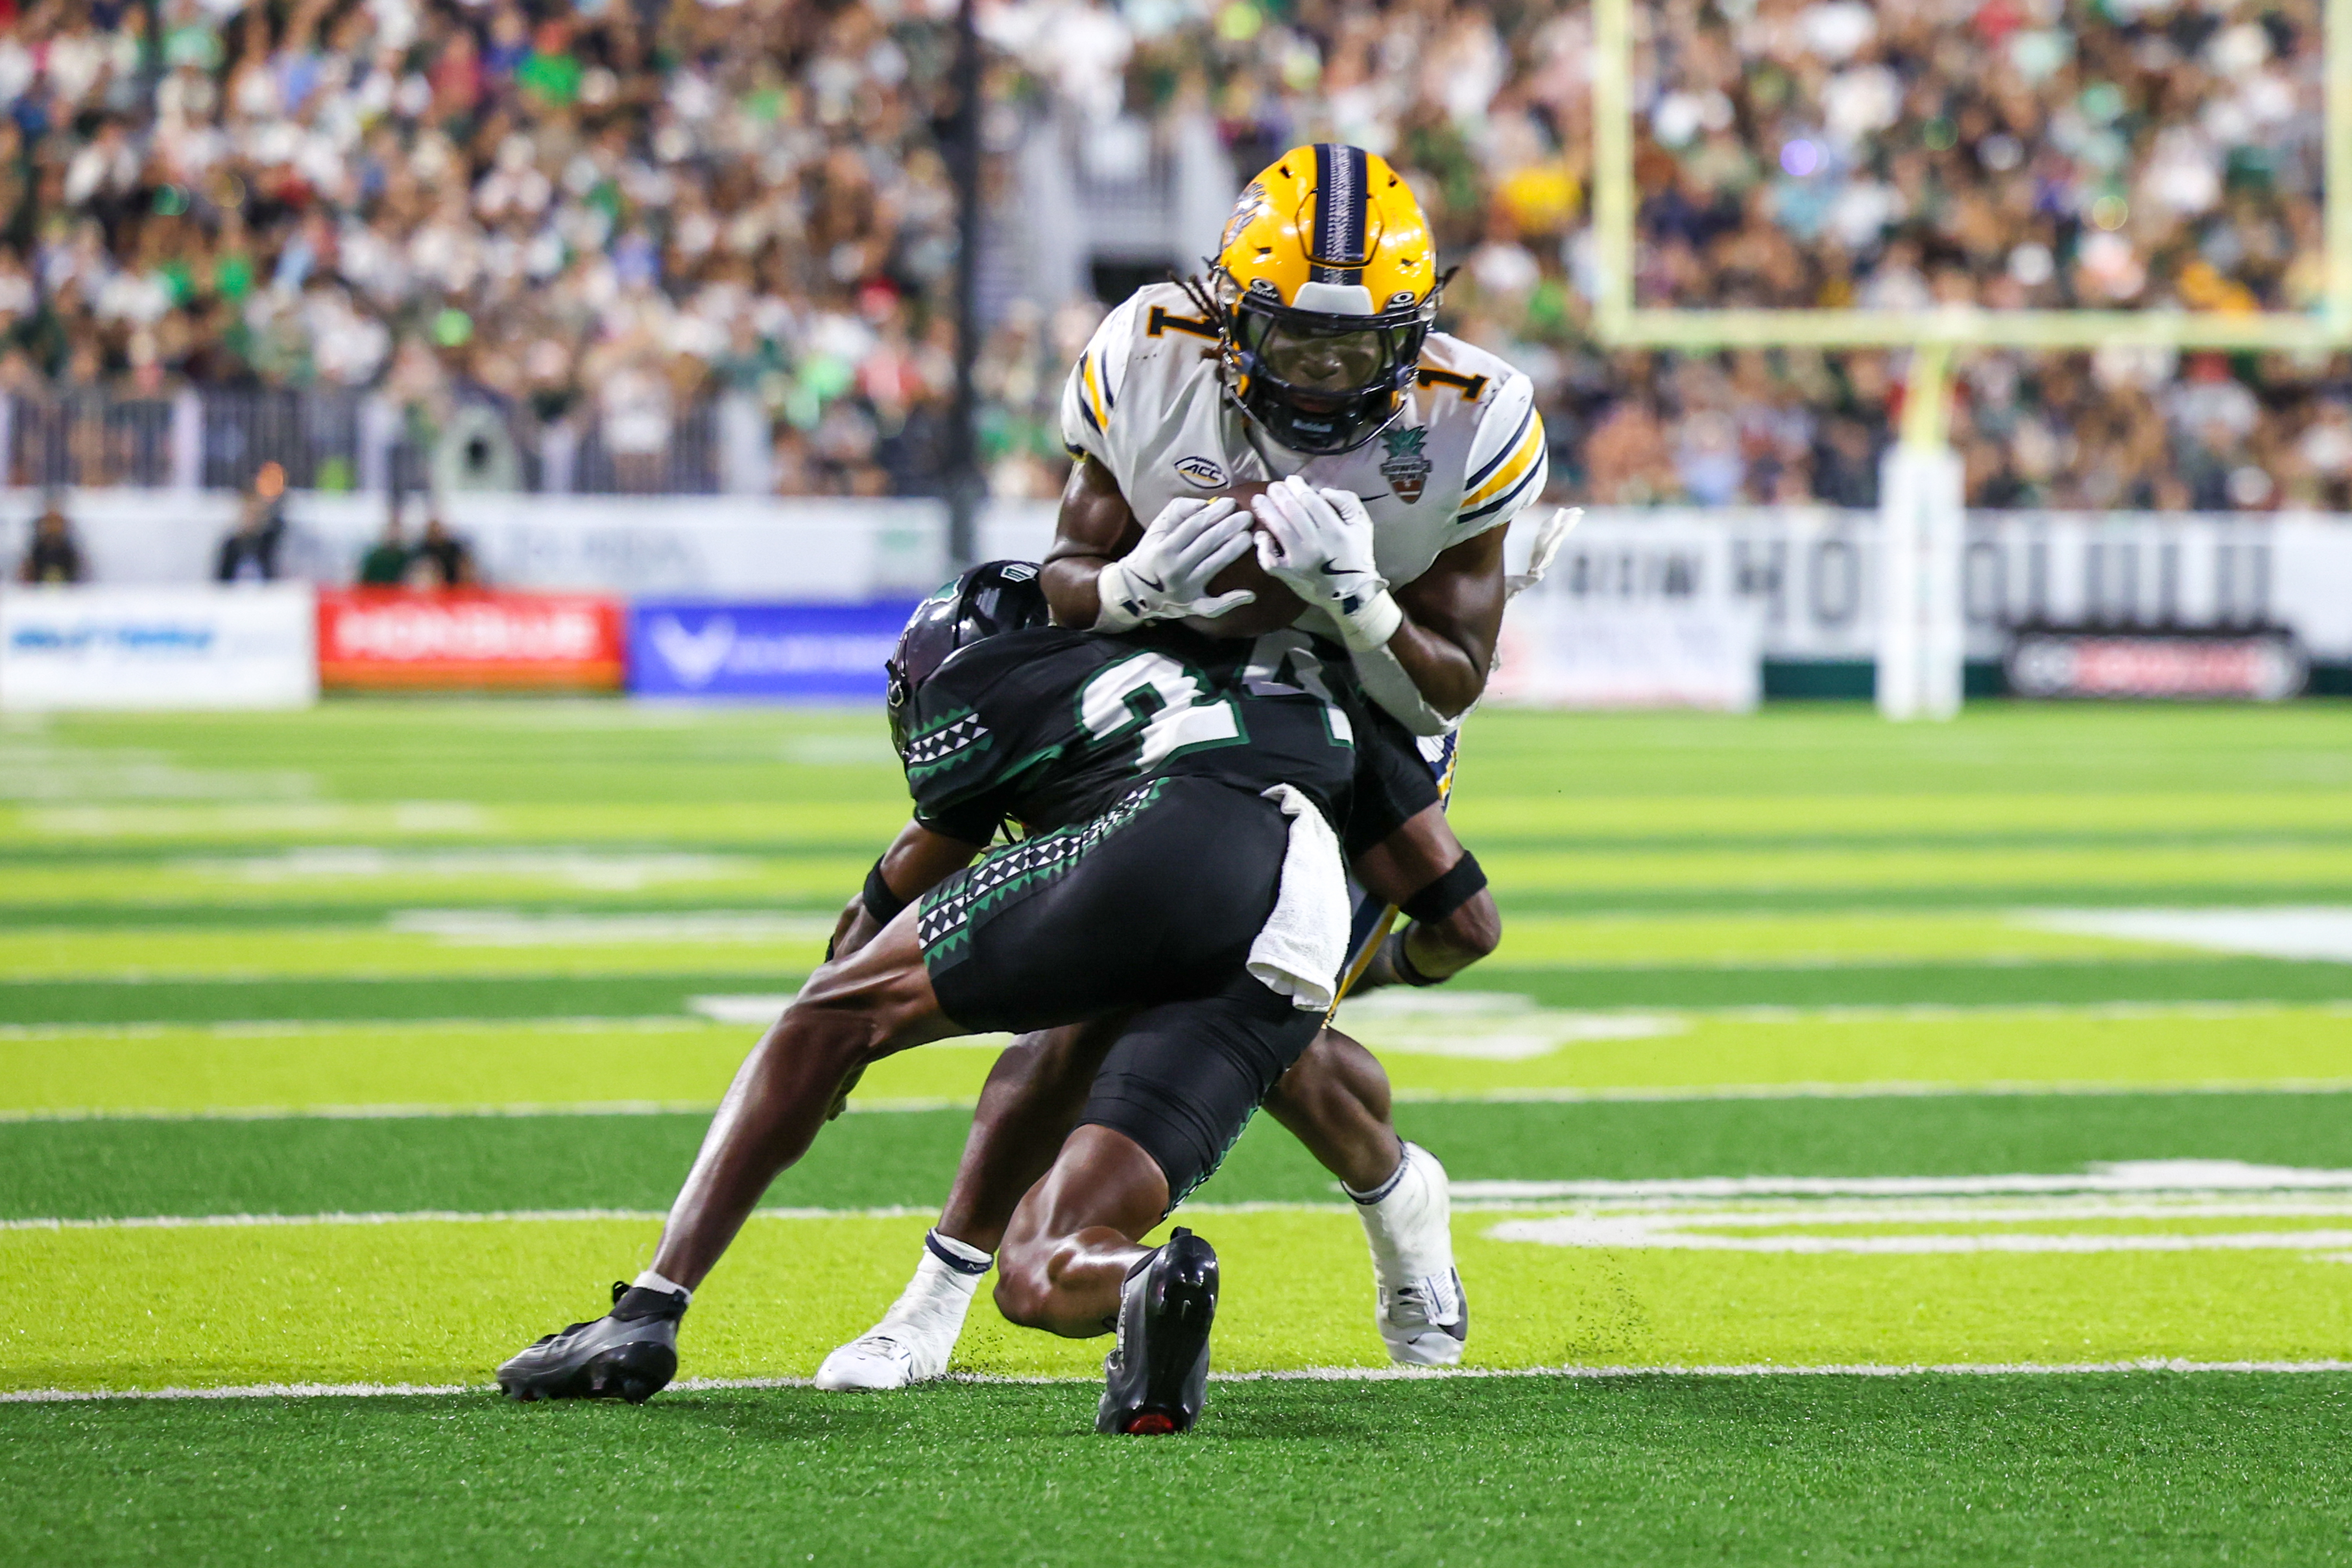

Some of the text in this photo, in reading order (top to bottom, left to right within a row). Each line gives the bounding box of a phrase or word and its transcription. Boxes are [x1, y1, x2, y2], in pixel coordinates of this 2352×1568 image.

[1146, 305, 1223, 342] 1
[1415, 366, 1491, 402] 1
[1181, 464, 1222, 481] ACC
[1074, 628, 1354, 776] 24
